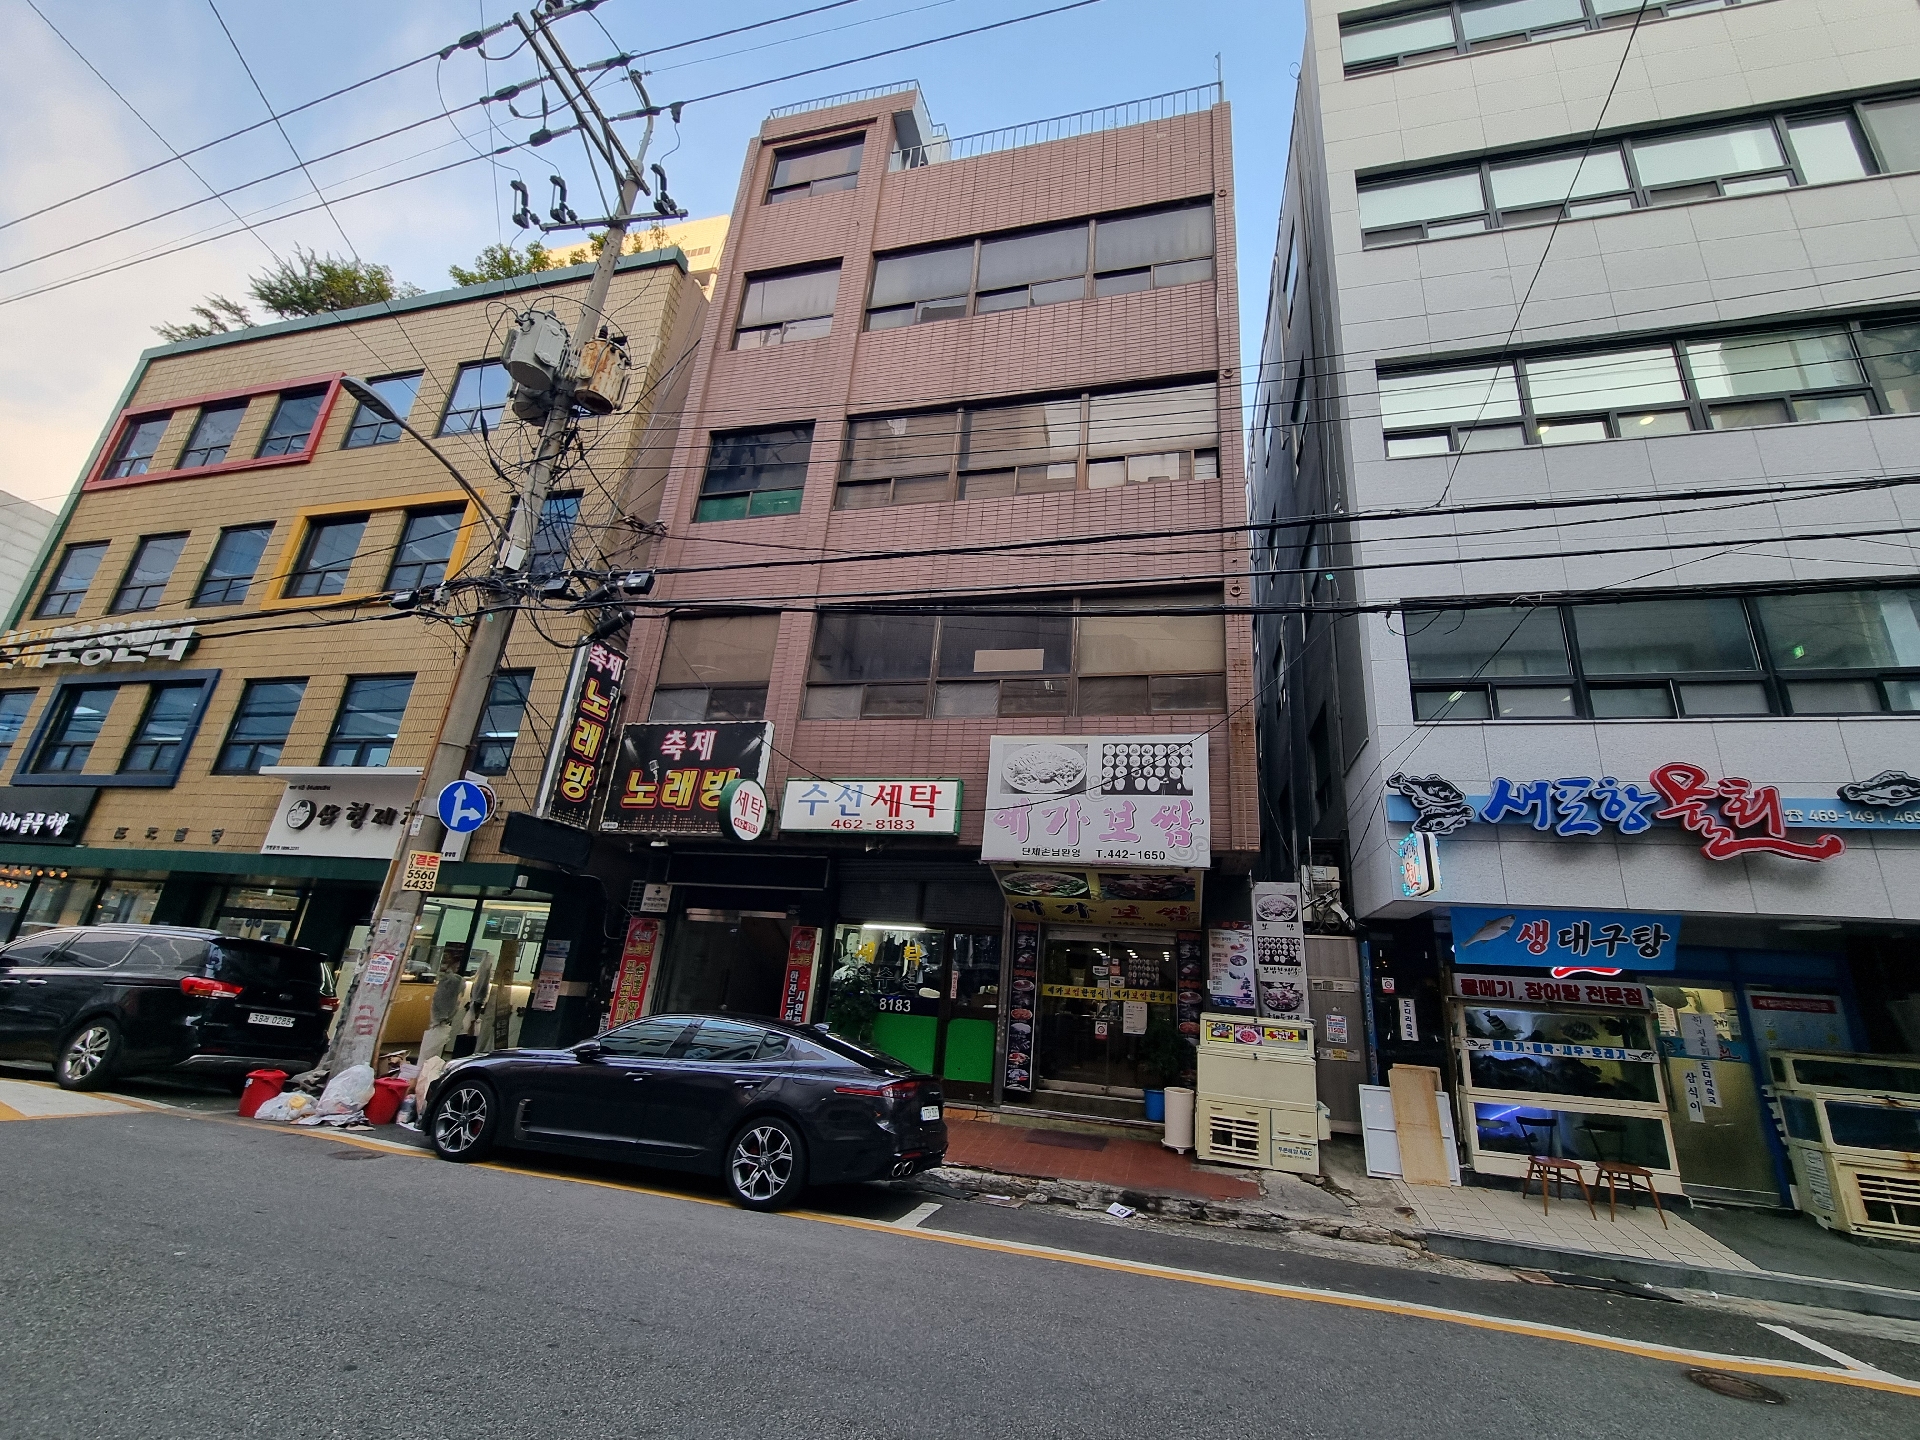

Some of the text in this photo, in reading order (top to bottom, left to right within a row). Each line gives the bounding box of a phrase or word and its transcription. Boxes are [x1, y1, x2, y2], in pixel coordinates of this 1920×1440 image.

[589, 644, 624, 682] 축제
[561, 677, 610, 802] 노래방
[660, 729, 718, 761] 축제
[620, 768, 740, 811] 노래방
[735, 789, 764, 823] 세탁
[1650, 762, 1846, 862] 물회
[19, 812, 46, 835] 골목
[831, 819, 915, 830] 462-8183
[415, 853, 441, 868] 결혼
[1022, 847, 1166, 861] 단체손님환영 T.442-1650
[404, 879, 433, 890] 4433
[407, 869, 436, 881] 5560
[1516, 919, 1671, 959] 생 대구탕
[879, 998, 911, 1012] 8183
[1525, 981, 1581, 1002] 장어탕
[1585, 985, 1644, 1006] 전문점
[1685, 1071, 1701, 1113] 삼식이
